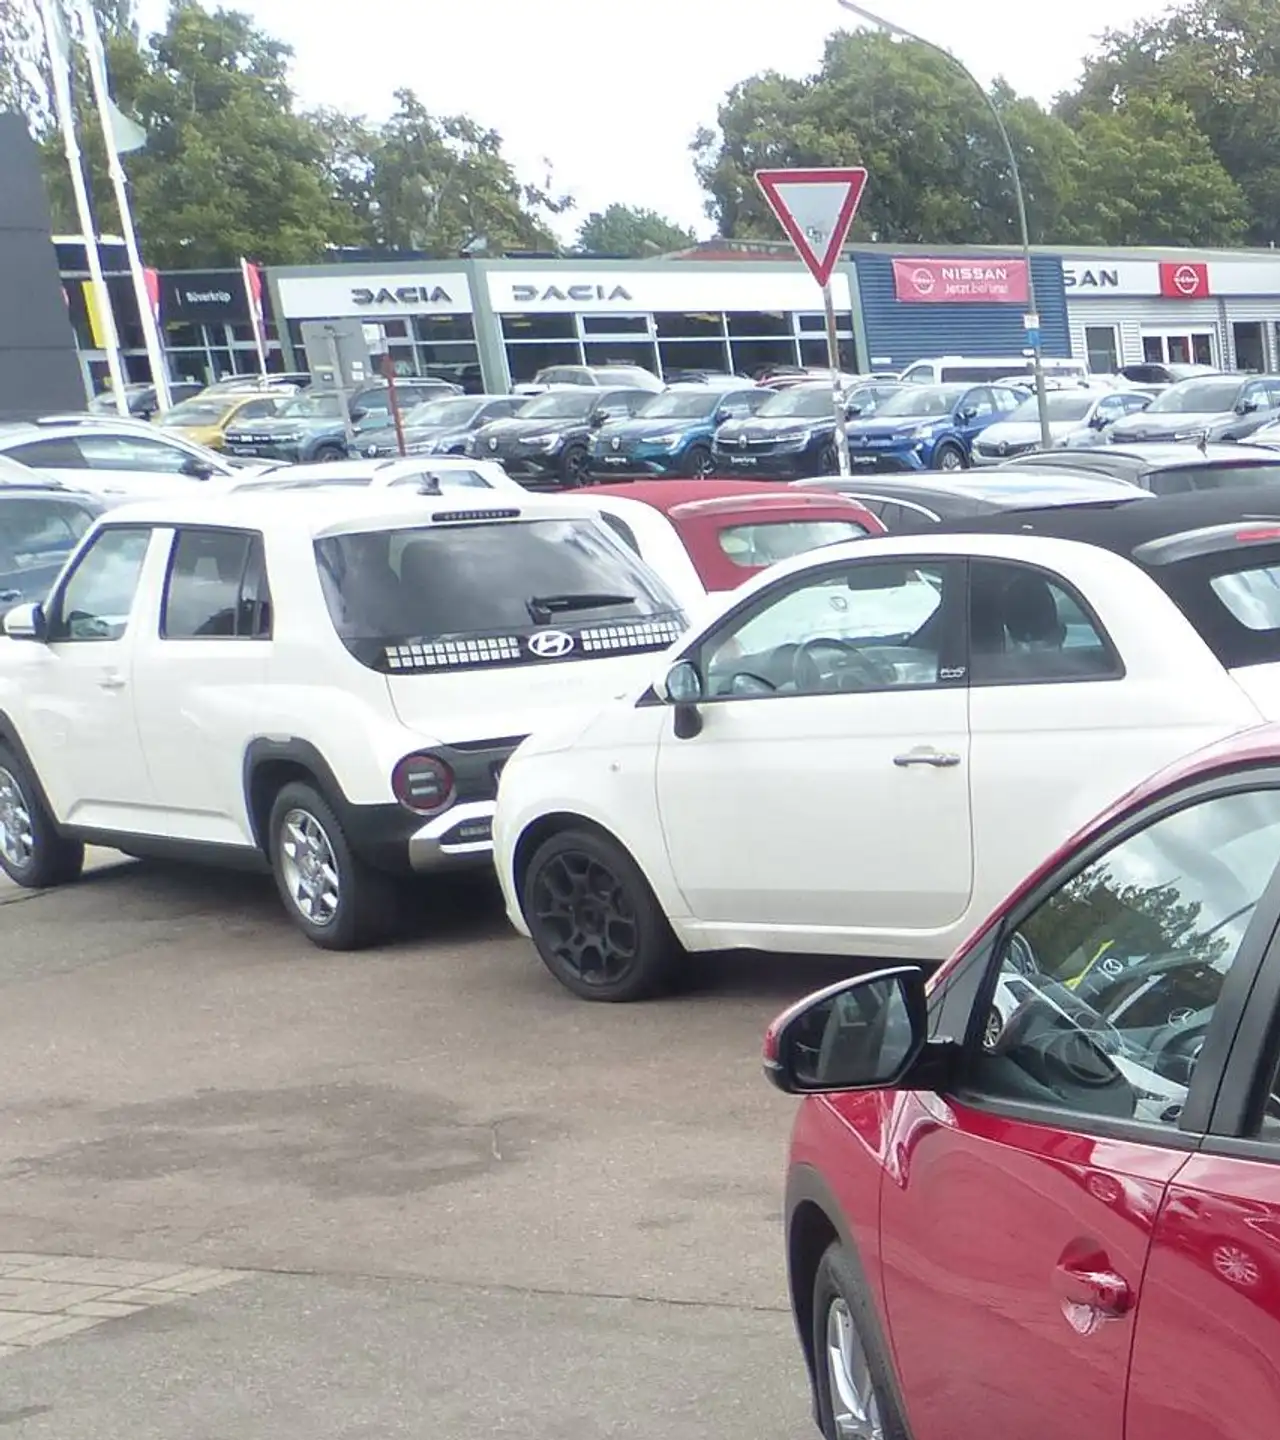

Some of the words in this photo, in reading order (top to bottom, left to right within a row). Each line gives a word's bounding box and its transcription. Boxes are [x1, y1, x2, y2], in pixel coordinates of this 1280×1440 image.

[941, 267, 1008, 282] NISSAN
[351, 286, 452, 304] DACIA
[511, 284, 633, 301] DACIA
